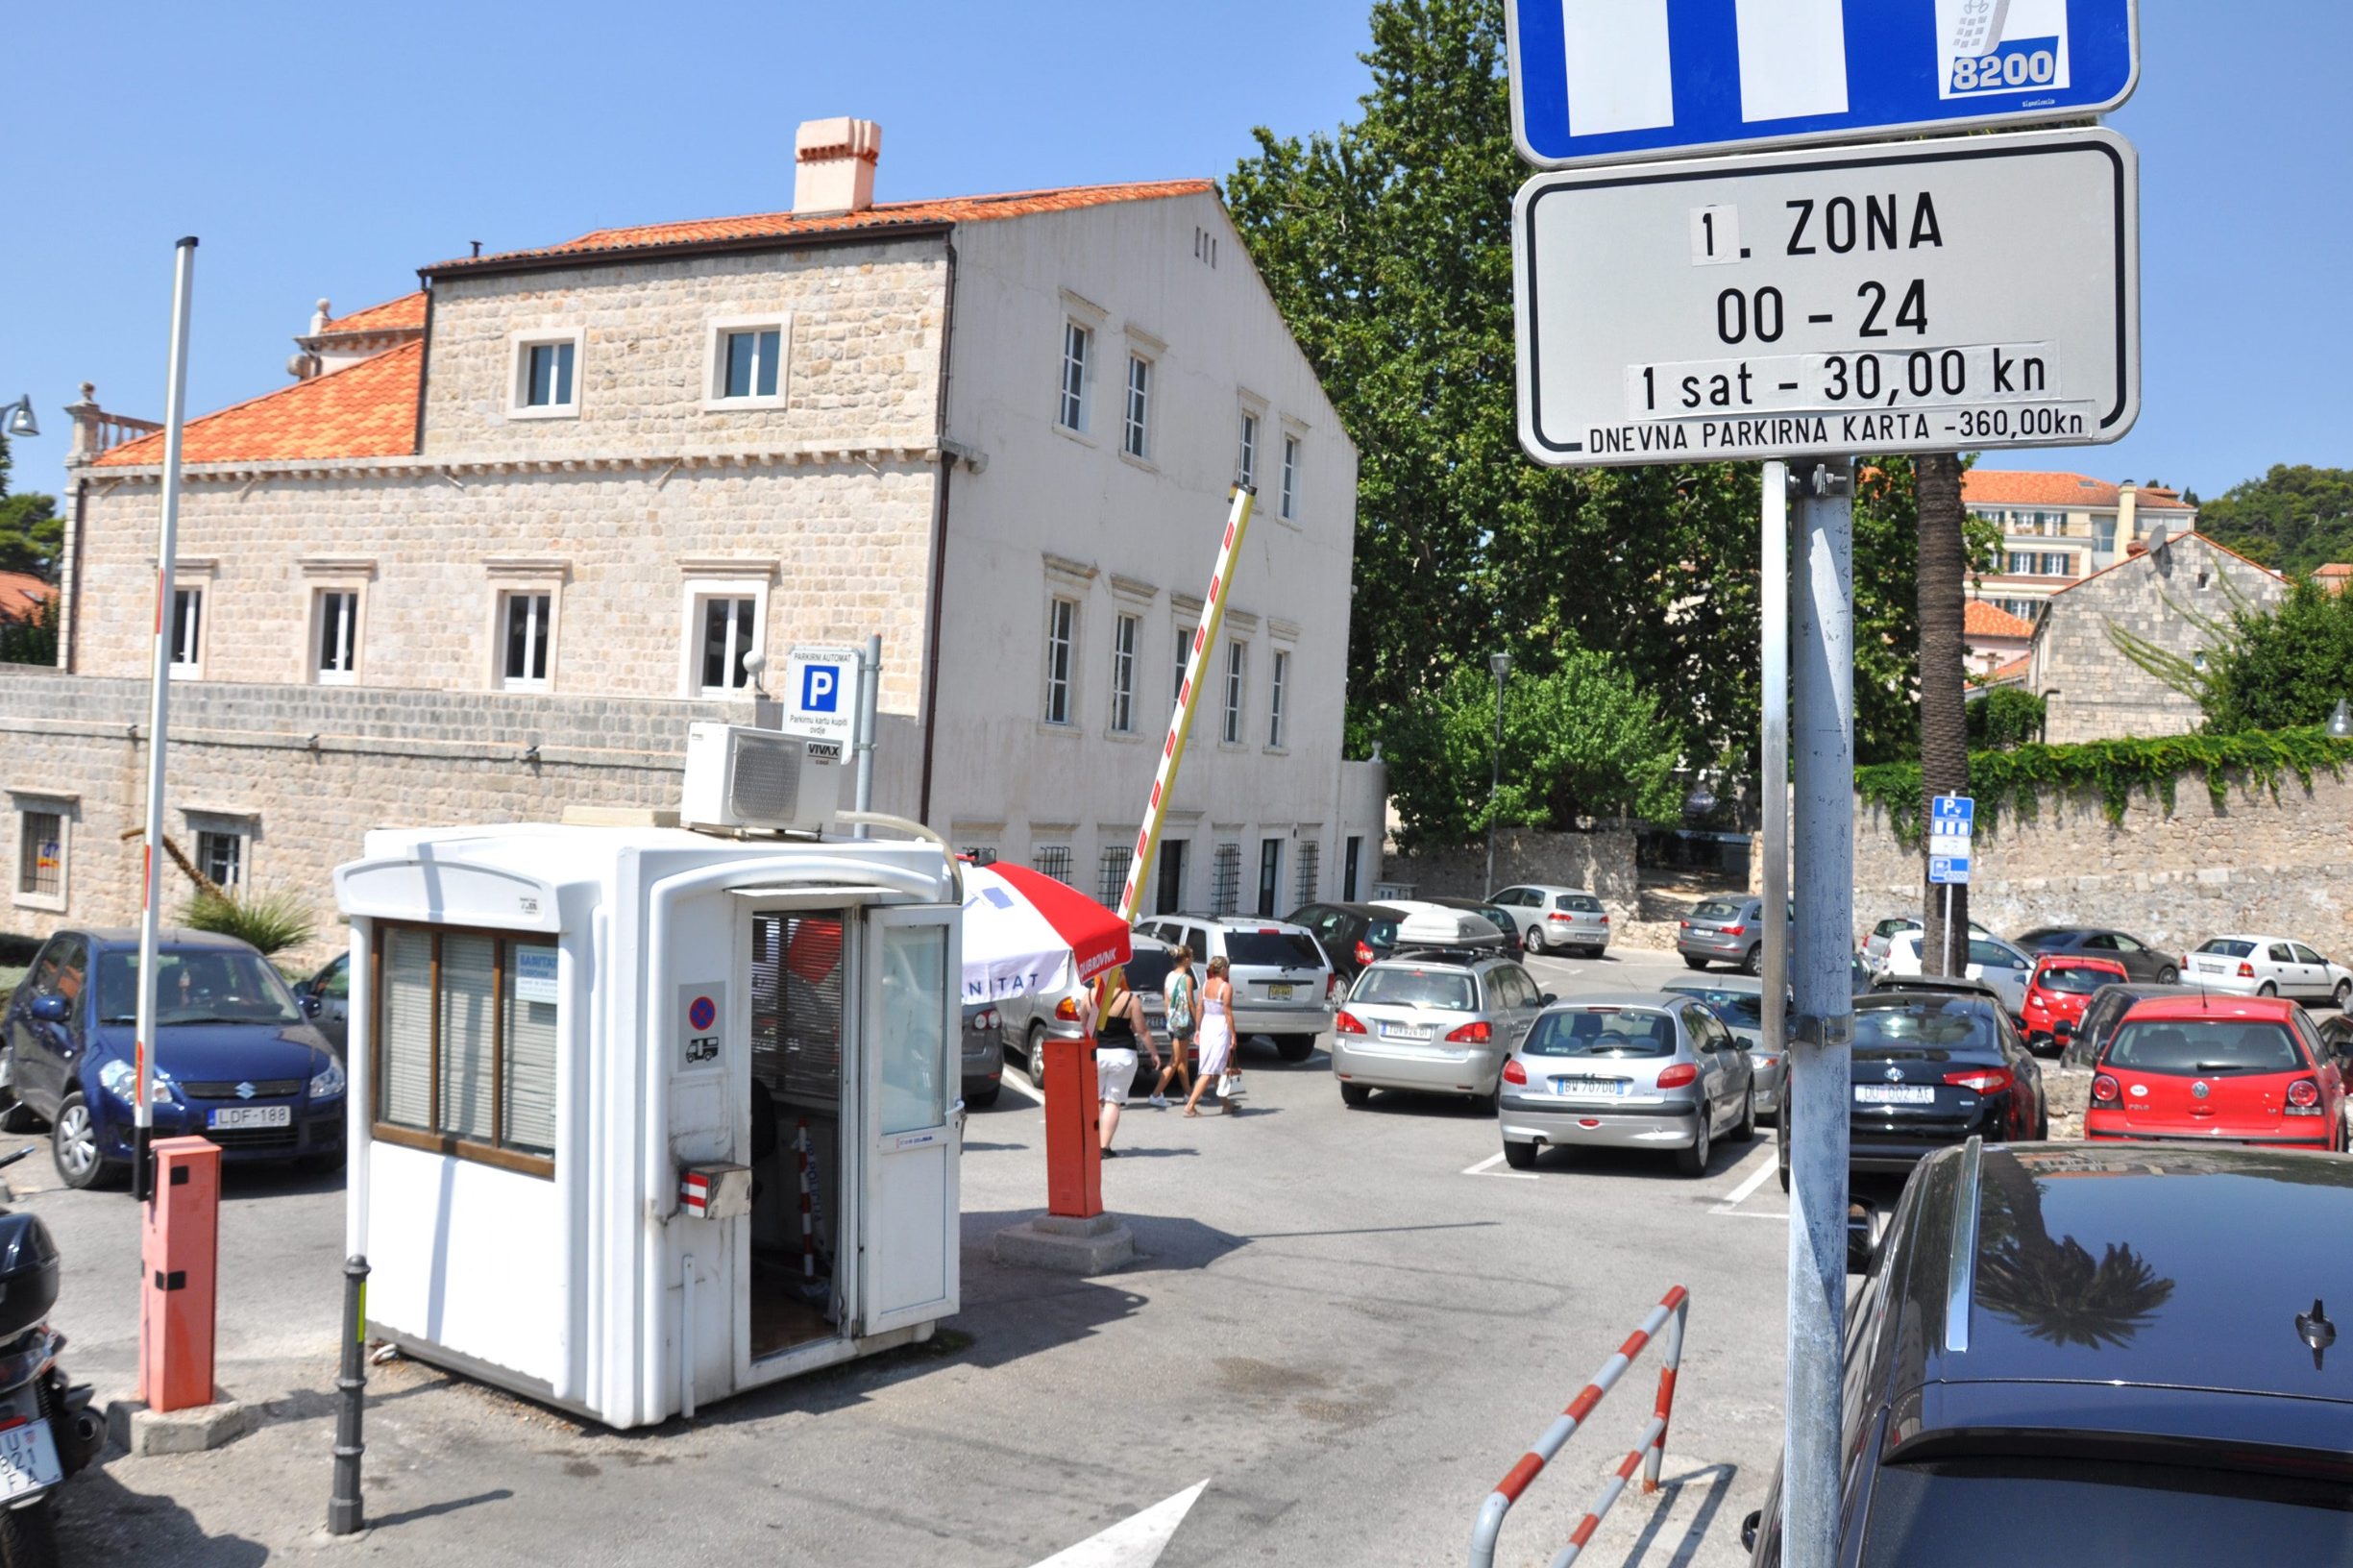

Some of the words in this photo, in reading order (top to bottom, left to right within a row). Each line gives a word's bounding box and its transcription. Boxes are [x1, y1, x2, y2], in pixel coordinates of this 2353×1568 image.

[1953, 51, 2053, 89] 8200
[1703, 211, 1751, 258] 1.
[1786, 191, 1943, 255] ZONA
[1717, 286, 1784, 345] 00
[1808, 313, 1833, 324] -
[1857, 279, 1928, 337] 24
[1642, 366, 1655, 410] 1
[1681, 361, 1752, 408] sat
[1824, 349, 1966, 406] 30,00
[1994, 348, 2045, 393] kn
[1590, 424, 1688, 453] DNEVNA
[1703, 417, 1827, 448] PARKIRNA
[1843, 413, 1929, 442] KARTA
[794, 652, 821, 662] PARKIRNI
[822, 653, 852, 663] AUTOMAT
[809, 671, 833, 707] P
[808, 743, 839, 756] VIVAX
